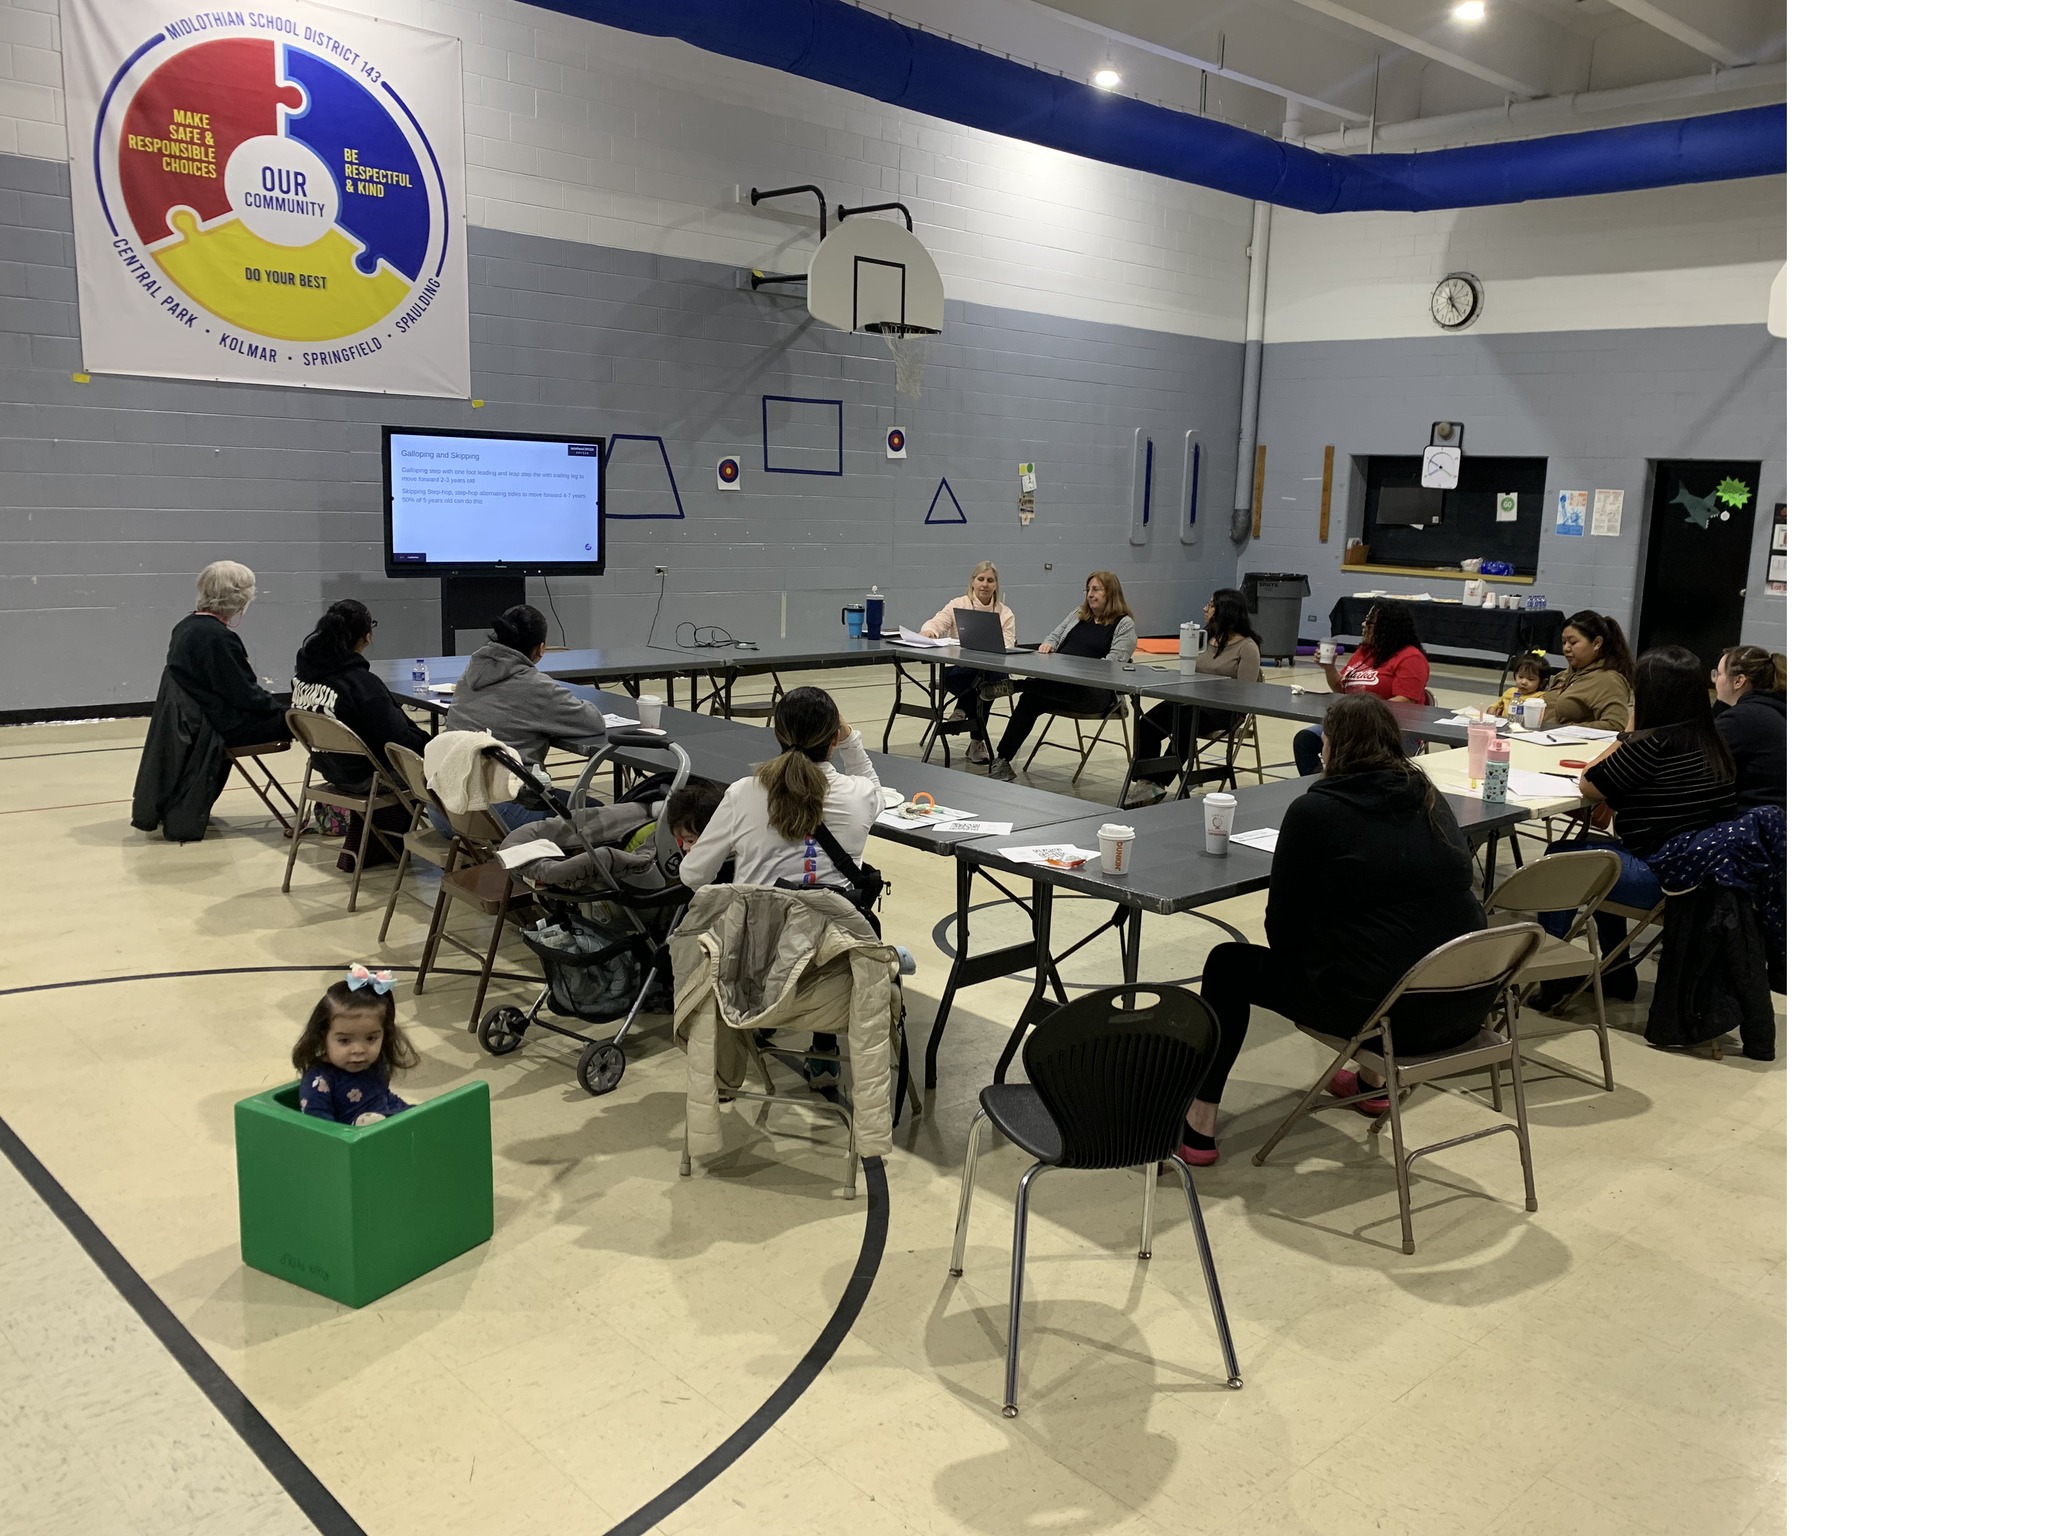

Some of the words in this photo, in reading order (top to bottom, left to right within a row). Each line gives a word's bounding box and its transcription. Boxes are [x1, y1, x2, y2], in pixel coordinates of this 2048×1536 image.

[164, 11, 245, 40] MIDLOTHIAN
[248, 12, 299, 37] SCHOOL
[304, 26, 360, 65] DISTRICT
[360, 61, 381, 83] 143
[173, 108, 211, 129] MAKE
[169, 124, 201, 144] SAFE
[204, 131, 215, 146] &
[128, 133, 216, 162] RESPONSIBLE
[344, 148, 359, 163] BE
[162, 156, 217, 178] CHOICES
[345, 163, 413, 188] RESPECTFUL
[261, 166, 308, 198] OUR
[346, 179, 355, 193] &
[358, 182, 385, 198] KIND
[244, 191, 325, 218] COMMUNITY
[245, 267, 261, 282] DO
[265, 269, 296, 286] YOUR
[300, 274, 327, 290] BEST
[113, 238, 162, 299] CENTRAL
[160, 295, 199, 328] PARK
[219, 333, 277, 363] KOLMAR
[303, 337, 382, 366] SPRINGFIELD
[395, 278, 440, 333] SPAULDING
[401, 450, 434, 459] Galloping
[450, 452, 480, 461] Skipping
